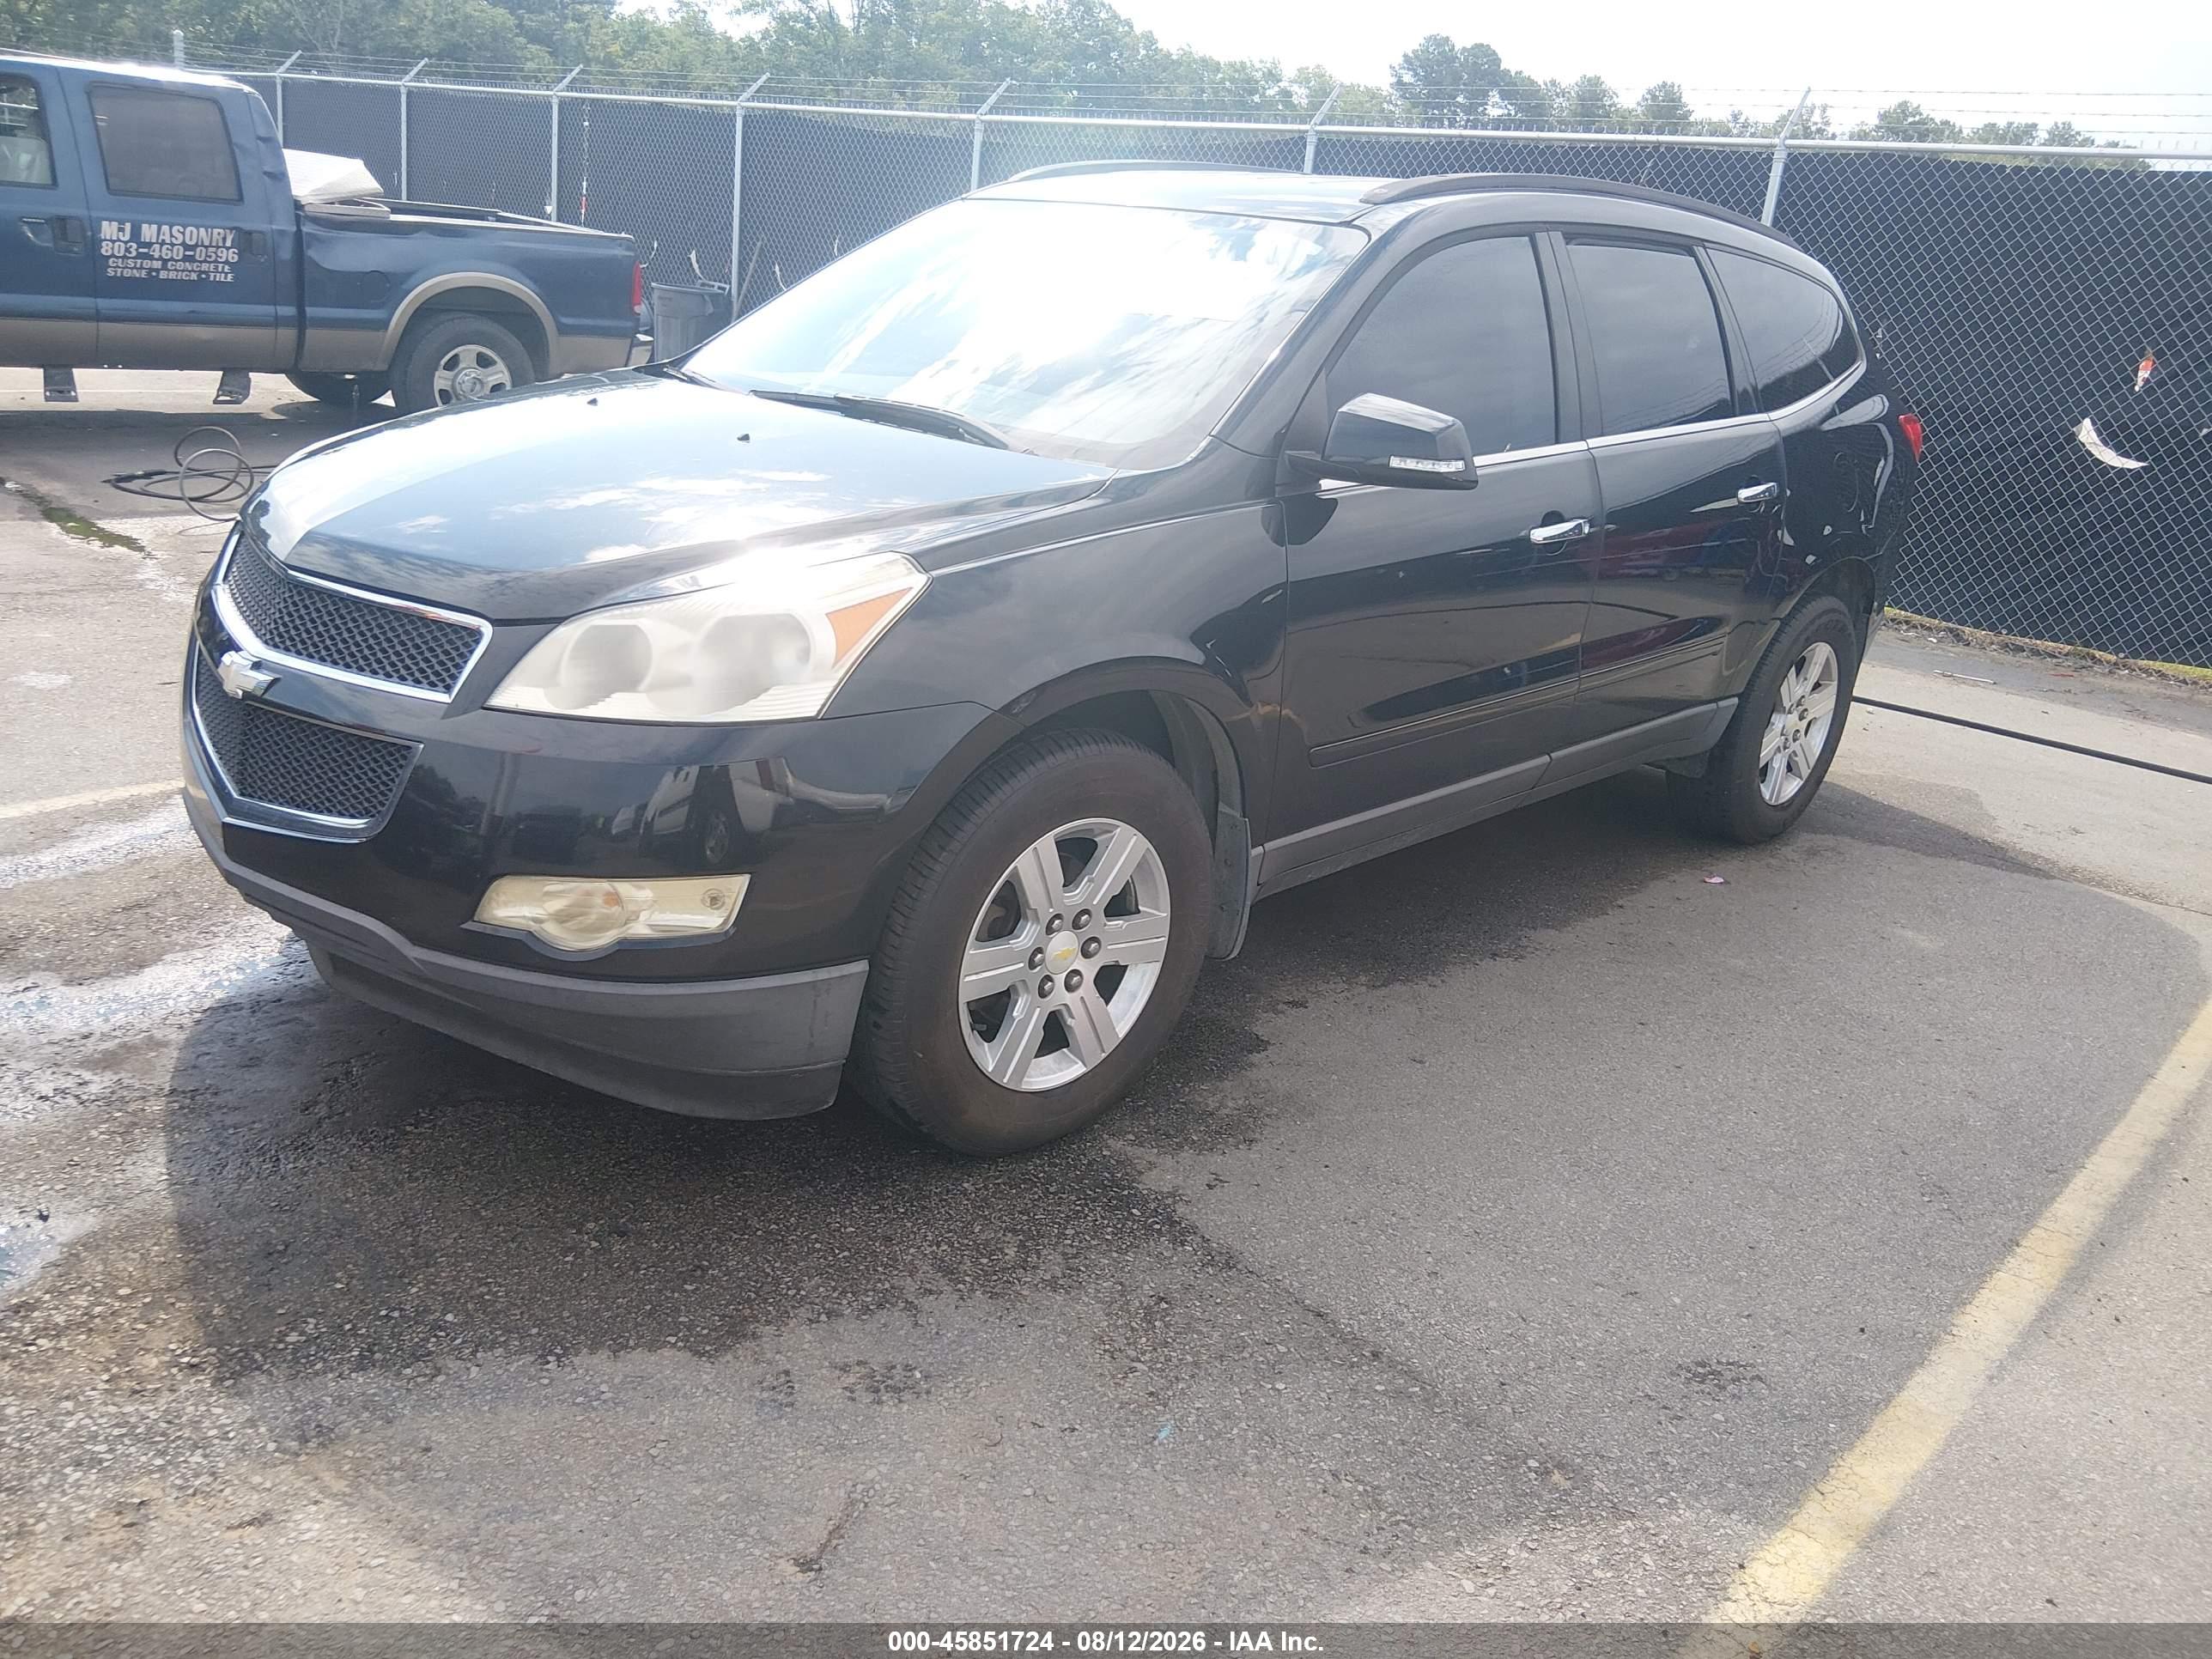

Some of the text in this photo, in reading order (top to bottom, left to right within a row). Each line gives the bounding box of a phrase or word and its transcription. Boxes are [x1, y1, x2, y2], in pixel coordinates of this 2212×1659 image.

[100, 220, 236, 247] MJ MASONRY
[100, 241, 239, 263] 803-460-0596
[108, 258, 232, 272] CUSTOM CONCRETE
[106, 268, 234, 283] STONE BRICK TILE
